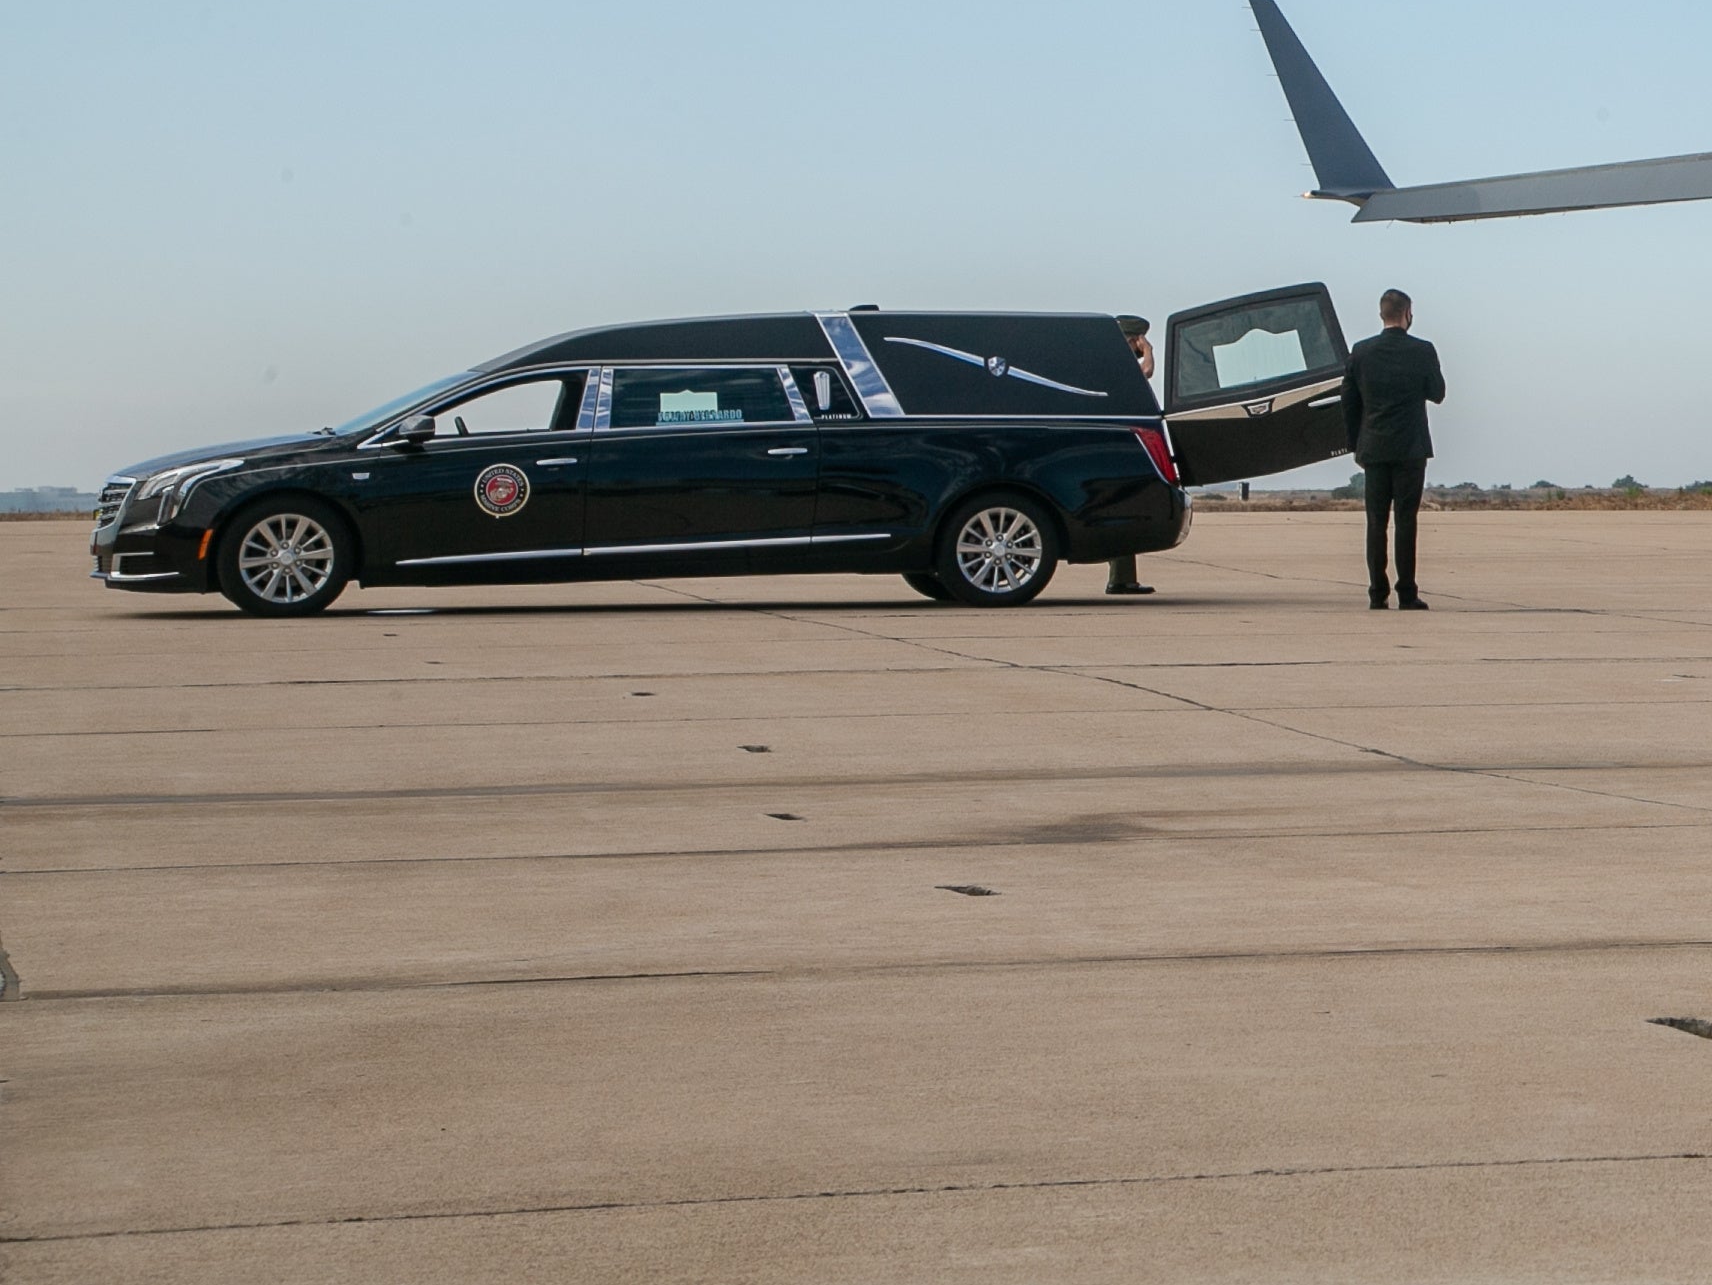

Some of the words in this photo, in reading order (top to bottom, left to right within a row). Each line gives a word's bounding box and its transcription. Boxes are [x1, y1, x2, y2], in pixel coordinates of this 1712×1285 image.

[481, 468, 504, 483] UNITED
[505, 468, 524, 486] STATES
[480, 494, 500, 512] MARINE
[500, 498, 521, 512] CORPS
